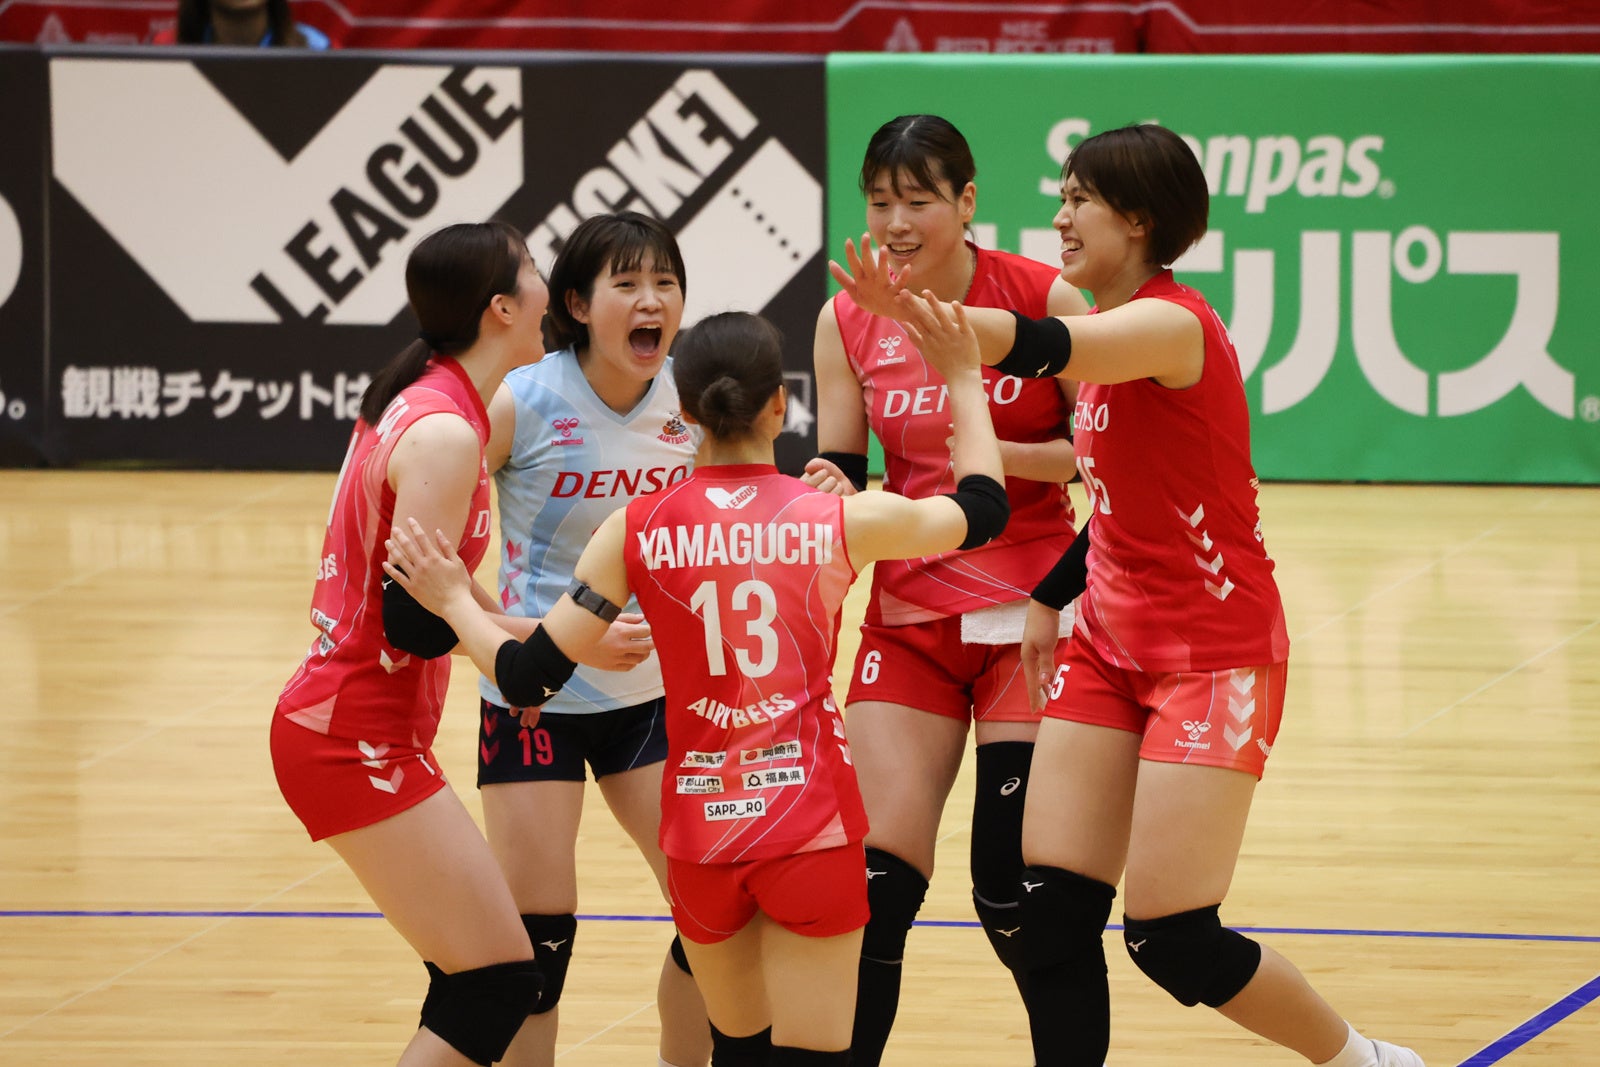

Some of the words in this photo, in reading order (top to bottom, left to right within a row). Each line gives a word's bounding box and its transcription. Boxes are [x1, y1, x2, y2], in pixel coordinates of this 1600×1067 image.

[1039, 118, 1385, 213] Snpas
[249, 66, 523, 324] LEAGUE
[876, 355, 907, 367] hummel
[726, 485, 757, 510] LEAGUE
[637, 522, 833, 571] YAMAGUCHI
[690, 579, 780, 679] 13
[860, 650, 882, 685] 6
[686, 692, 797, 730] AIRYBEES
[518, 728, 554, 767] 19
[1174, 738, 1211, 751] hummel
[765, 770, 802, 785] 福島県
